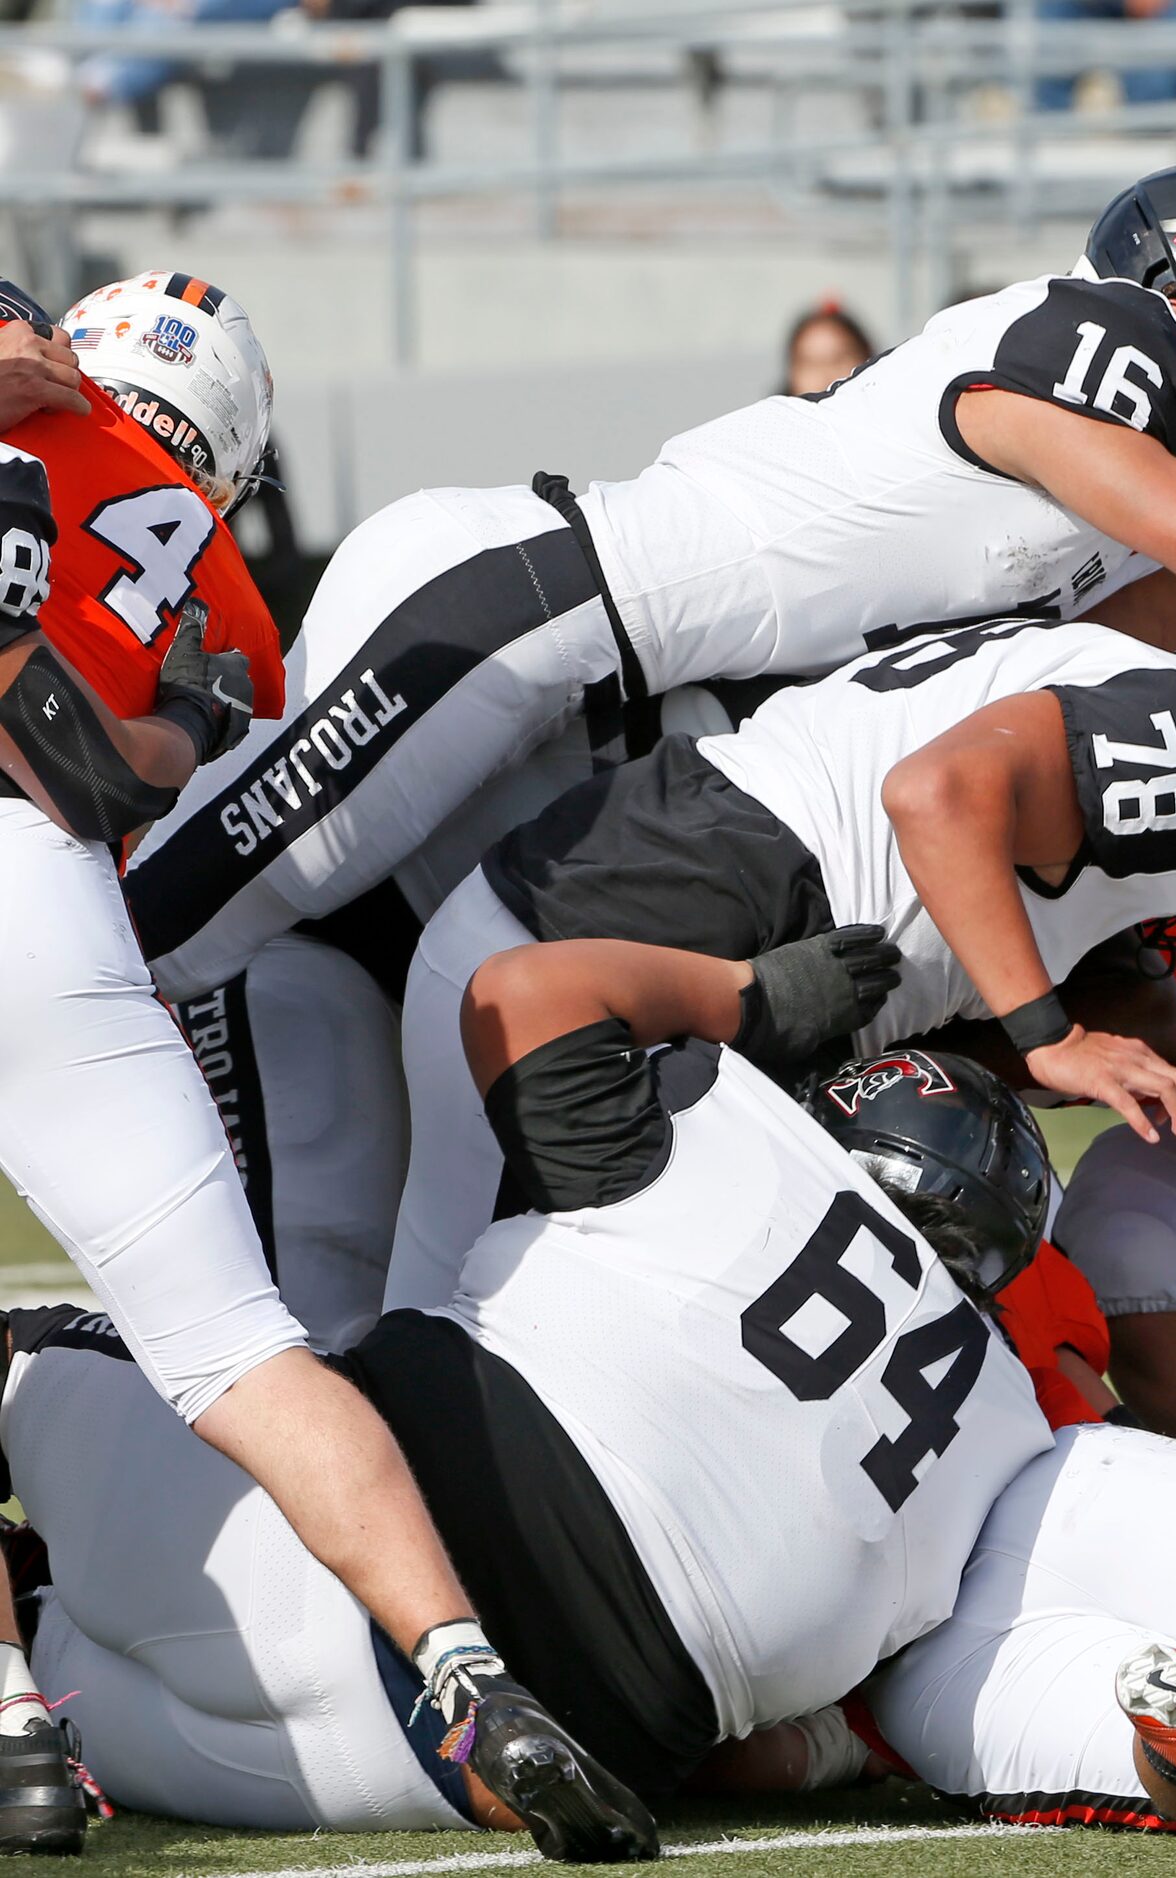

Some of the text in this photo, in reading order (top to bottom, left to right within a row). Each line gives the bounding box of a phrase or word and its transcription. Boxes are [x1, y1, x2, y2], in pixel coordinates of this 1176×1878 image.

[152, 315, 196, 348] 100
[1052, 320, 1165, 432] 16
[0, 527, 51, 618] 8
[80, 483, 217, 648] 4
[42, 693, 60, 721] KT
[219, 667, 408, 856] TROJANS
[740, 1190, 992, 1514] 64
